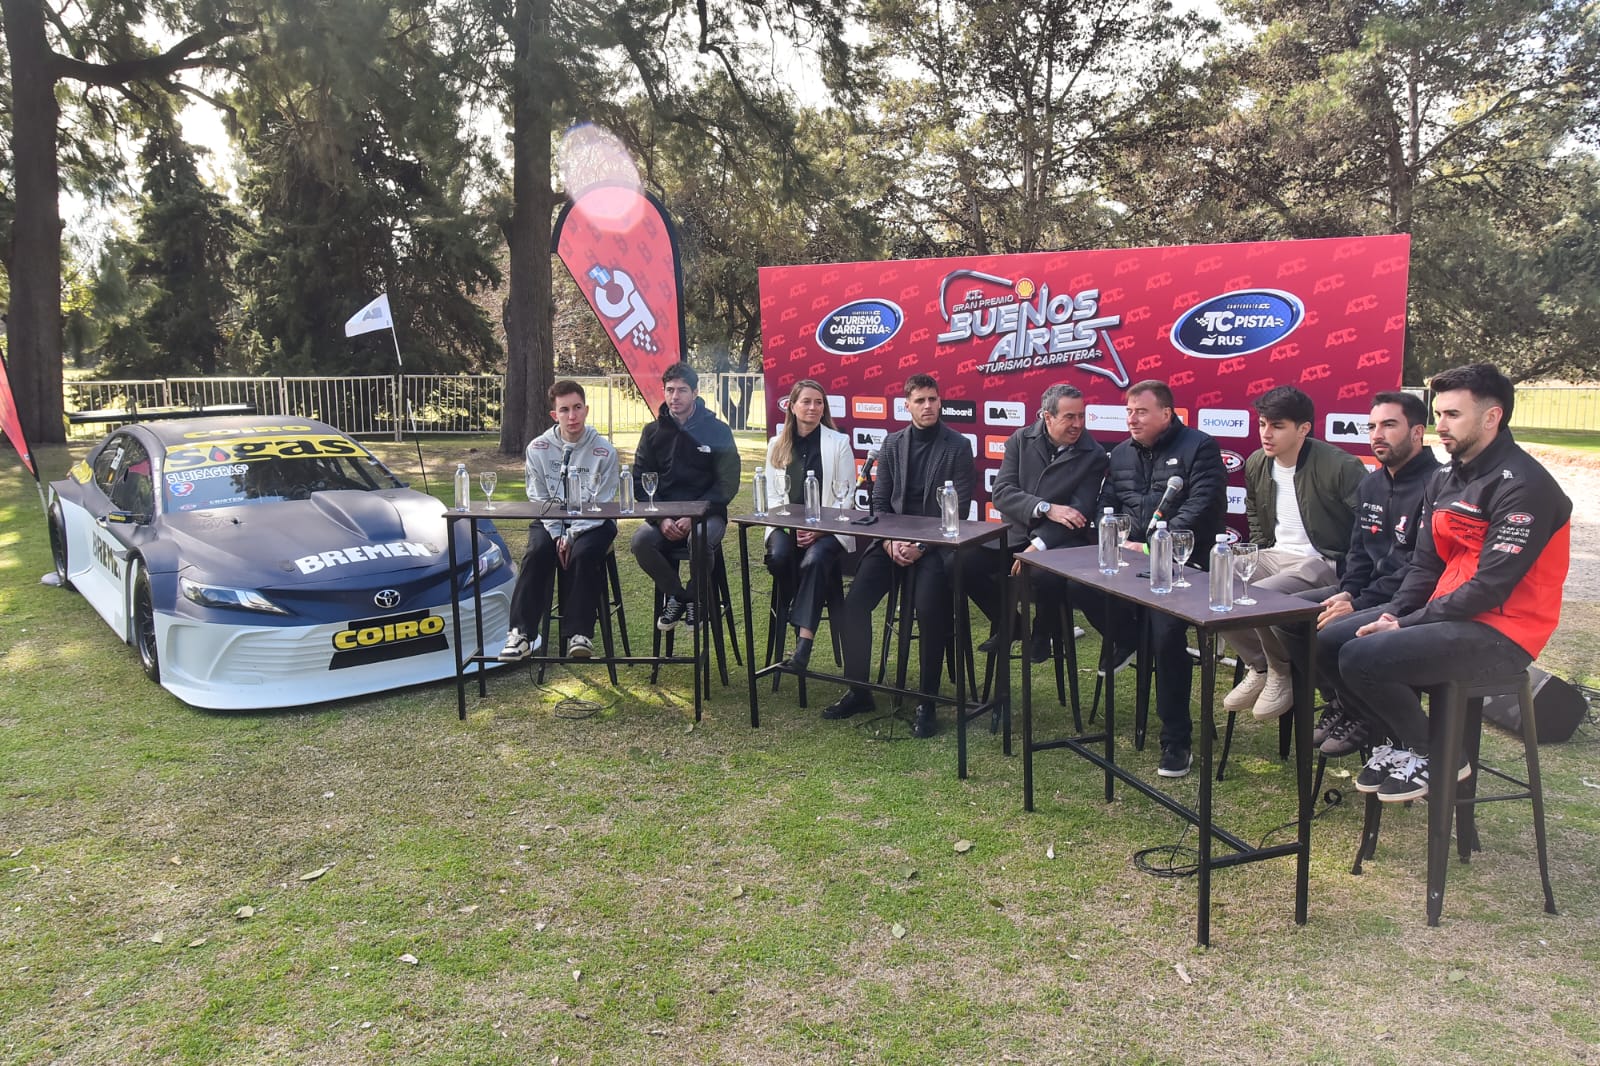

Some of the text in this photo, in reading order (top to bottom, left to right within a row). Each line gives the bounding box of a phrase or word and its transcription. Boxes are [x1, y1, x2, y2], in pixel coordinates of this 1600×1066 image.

[952, 295, 1014, 313] GRAN PREMIO
[840, 315, 881, 325] TURISMO
[937, 283, 1099, 343] BUENOS
[1203, 310, 1276, 332] TC PISTA
[830, 324, 885, 335] CARRETERA
[847, 336, 865, 345] RUS
[988, 315, 1120, 362] AIRES
[1217, 335, 1243, 346] RUS
[984, 348, 1097, 374] TURISMO CARRETERA
[941, 406, 973, 417] billboard
[989, 407, 1008, 420] BA
[184, 425, 312, 439] COIRO
[294, 541, 433, 575] BREMEN
[333, 615, 445, 651] COIRO
